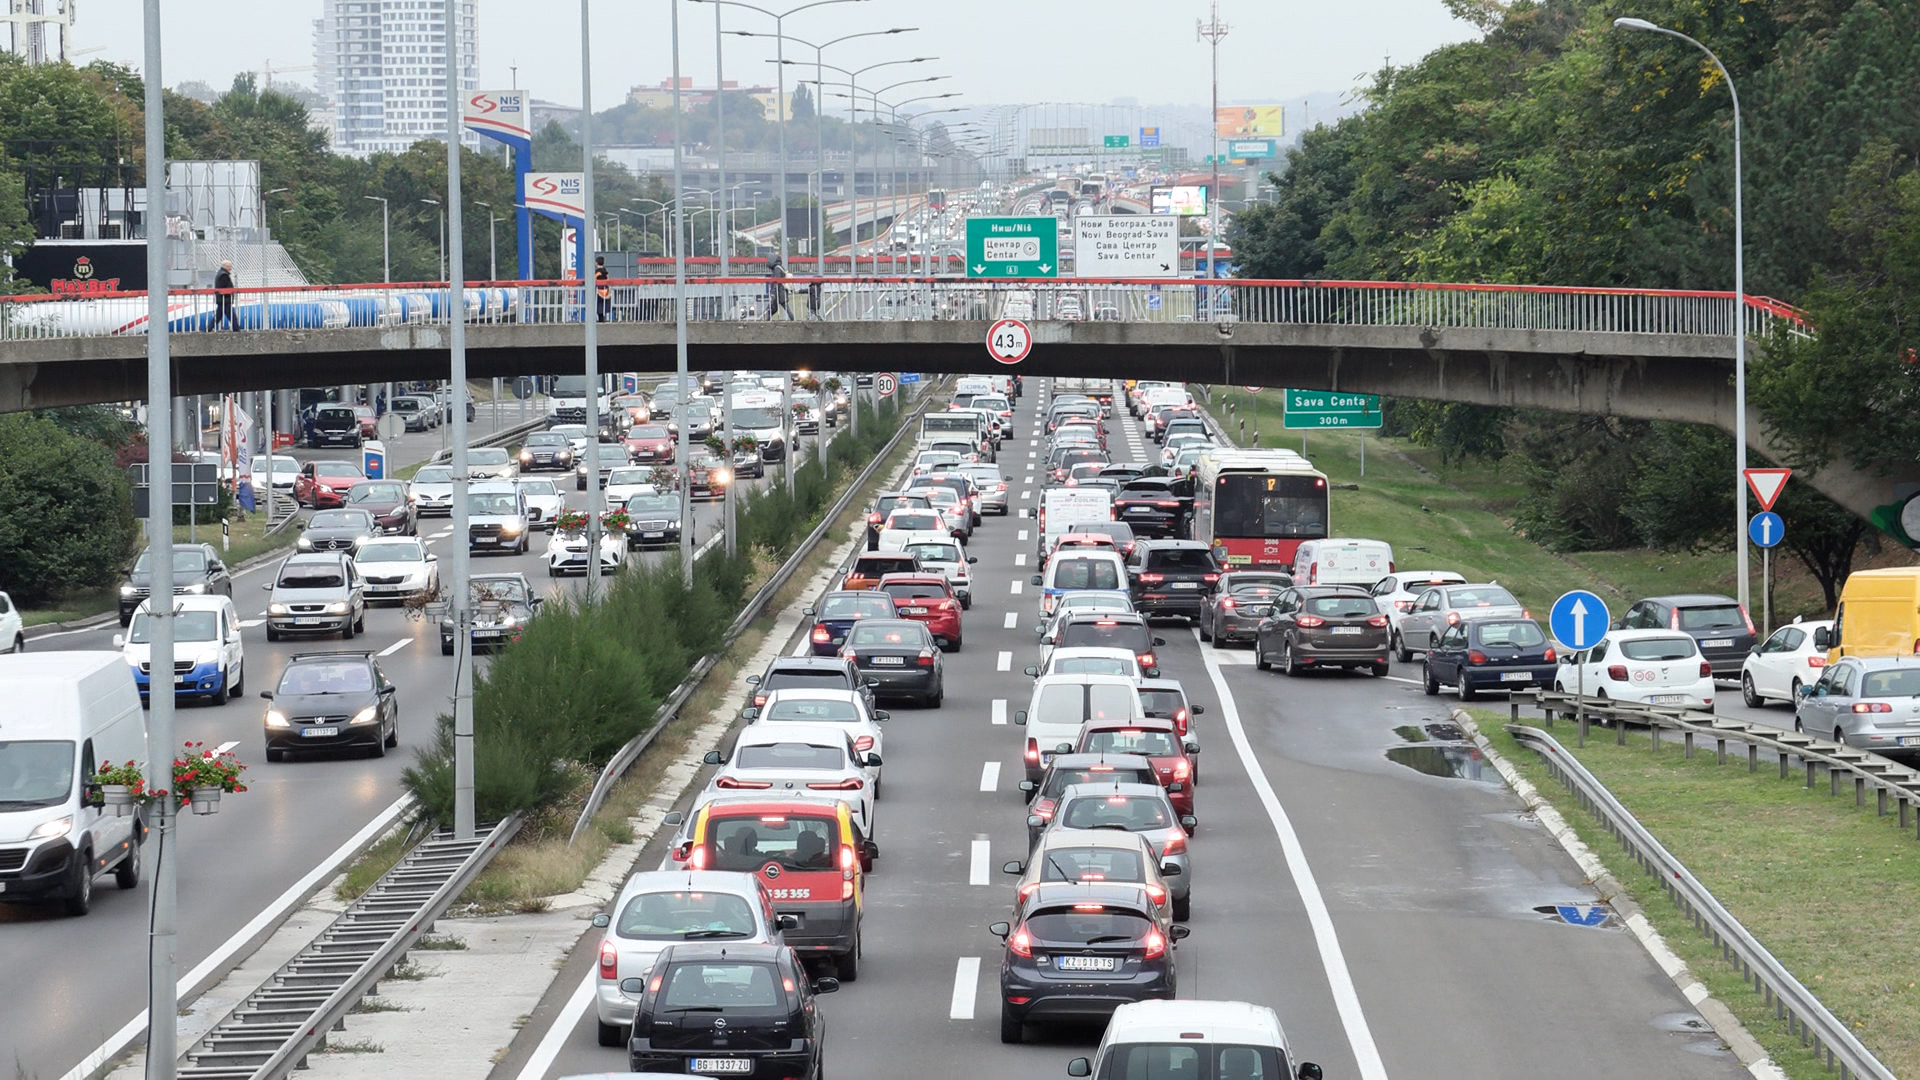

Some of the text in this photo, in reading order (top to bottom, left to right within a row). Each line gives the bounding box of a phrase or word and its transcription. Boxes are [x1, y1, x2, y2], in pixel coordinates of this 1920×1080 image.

[500, 96, 520, 105] NIS
[561, 179, 580, 187] NIS
[1081, 220, 1102, 228] Нови
[1081, 230, 1169, 240] Novi Beograd-Sava
[986, 241, 1020, 249] Центар
[1123, 242, 1157, 250] Центар
[986, 251, 1018, 259] Centar
[1098, 252, 1155, 260] Sava Centar
[879, 379, 892, 391] 80
[1295, 396, 1372, 407] Sava Centa
[1267, 478, 1276, 491] 17
[773, 888, 788, 899] 35
[789, 888, 810, 899] 355
[1065, 957, 1076, 967] KZ
[697, 1061, 708, 1070] BG
